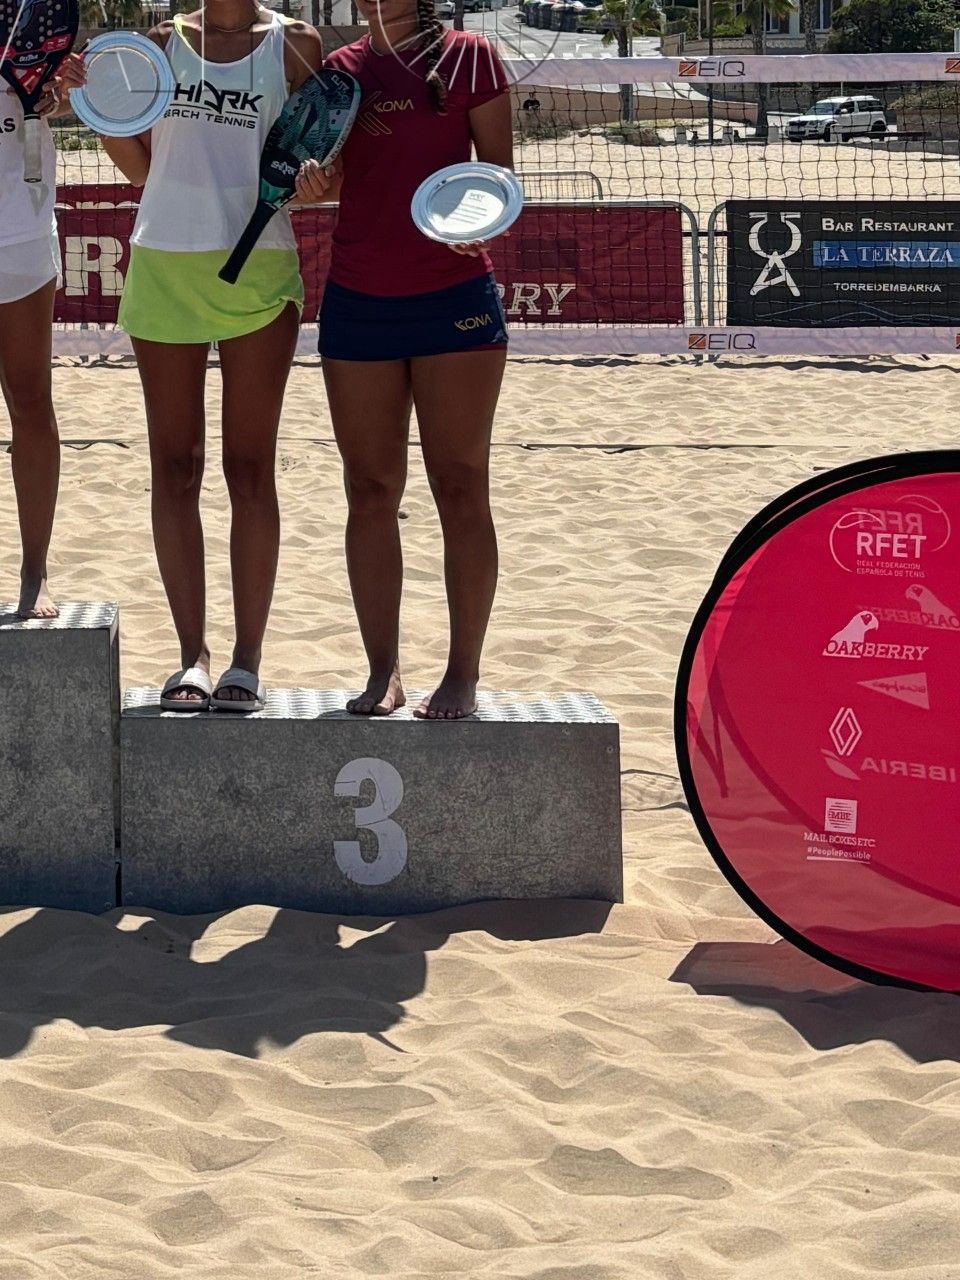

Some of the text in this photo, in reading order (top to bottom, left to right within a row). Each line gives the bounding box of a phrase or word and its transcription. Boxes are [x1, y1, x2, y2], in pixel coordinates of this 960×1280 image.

[678, 60, 745, 77] ZEIQ
[173, 79, 264, 115] HARK
[374, 98, 414, 114] KONA
[163, 108, 257, 129] EACH TENNIS
[822, 246, 954, 262] LA TERRAZA
[833, 282, 942, 293] TORREDEMBARRA
[454, 313, 493, 331] KONA
[688, 333, 757, 350] ZEIQ
[856, 531, 927, 559] RFET
[905, 570, 926, 578] TENIS
[825, 639, 929, 661] OAKBERRY
[332, 756, 407, 886] 3
[803, 832, 828, 843] MAIL
[829, 835, 856, 846] BOXES
[807, 846, 871, 860] #PeoplePossible
